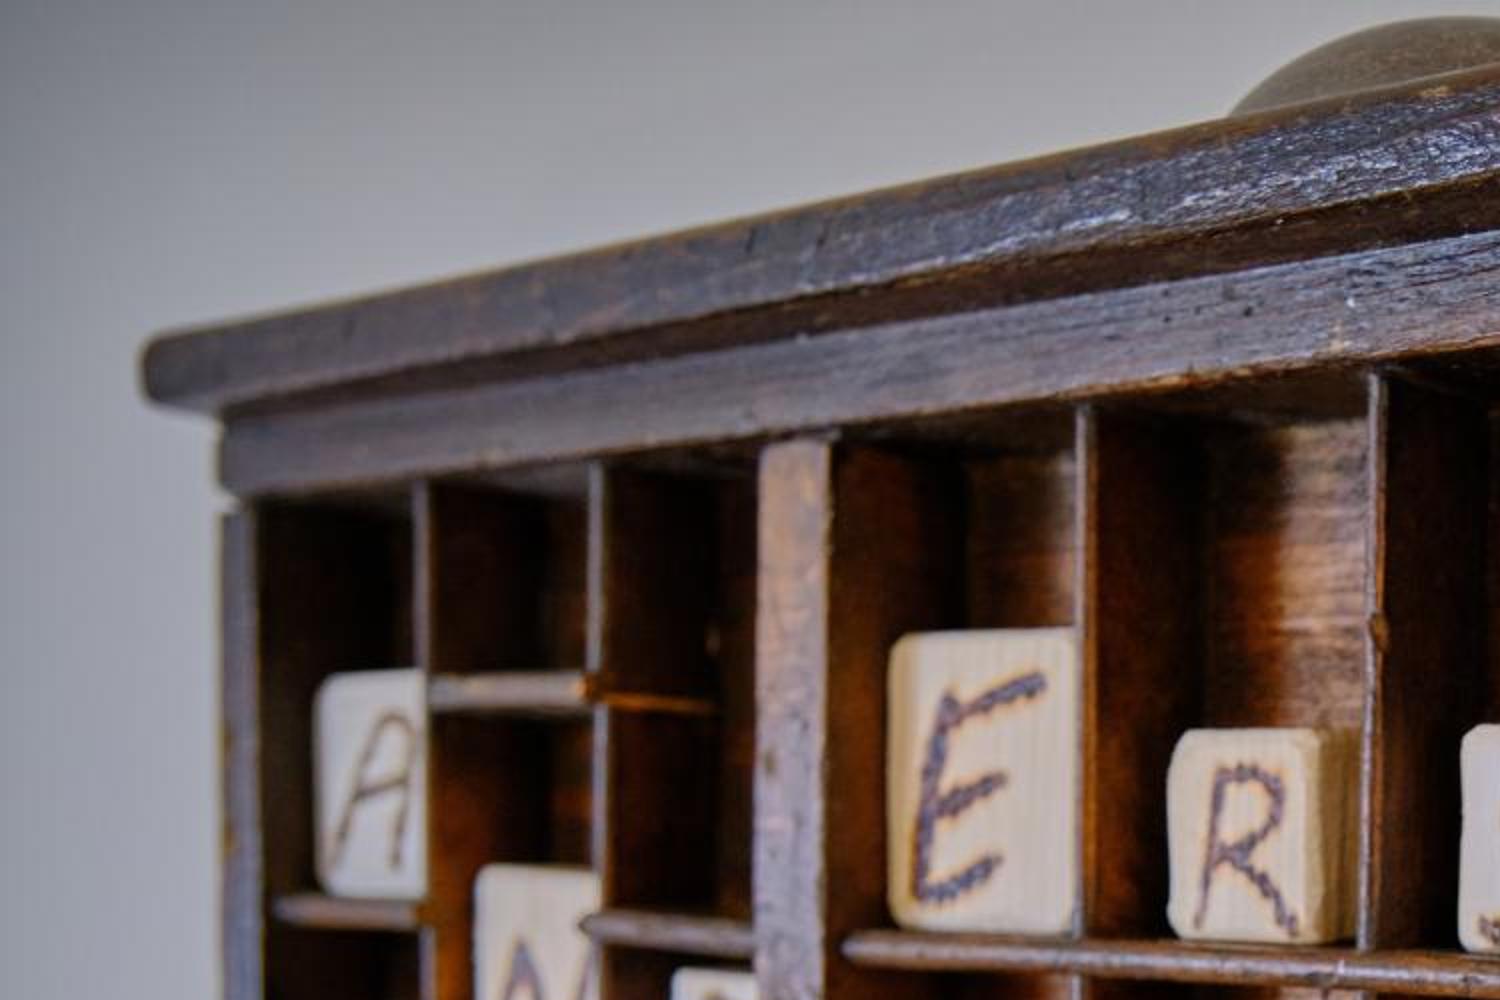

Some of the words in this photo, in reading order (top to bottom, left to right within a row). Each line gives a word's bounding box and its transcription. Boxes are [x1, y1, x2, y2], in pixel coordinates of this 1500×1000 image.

[330, 711, 419, 871] A
[911, 671, 1048, 906] E
[1193, 760, 1300, 938] R
